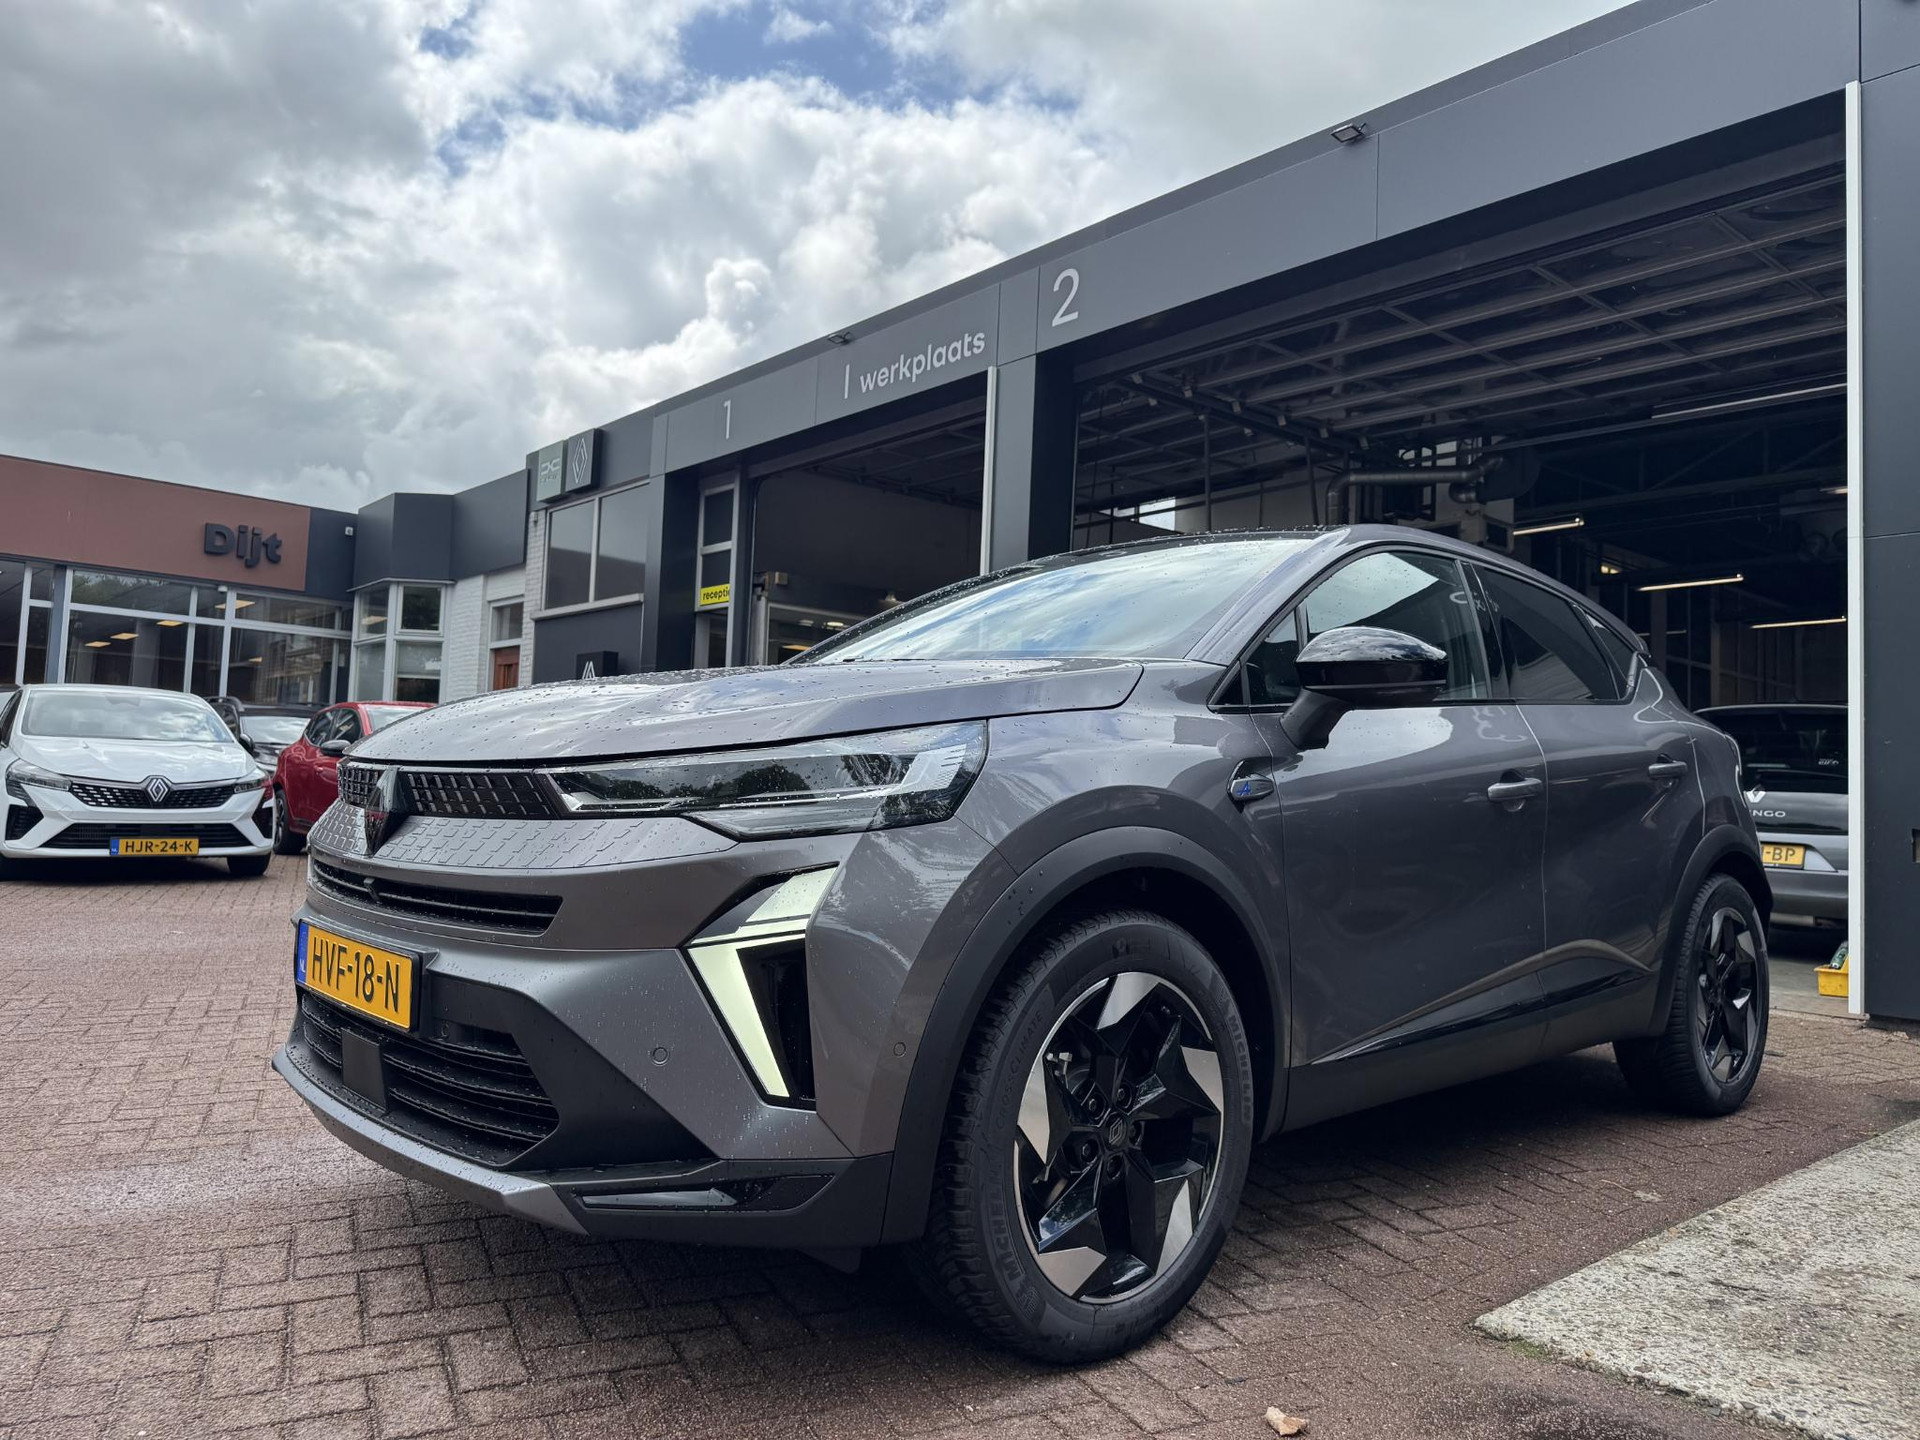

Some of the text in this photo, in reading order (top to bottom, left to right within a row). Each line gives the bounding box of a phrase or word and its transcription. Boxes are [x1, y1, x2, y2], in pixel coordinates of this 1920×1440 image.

[1051, 268, 1080, 328] 2
[860, 332, 986, 394] werkplaats
[723, 400, 731, 440] 1
[204, 523, 283, 569] Dijt
[1750, 809, 1786, 818] NGO
[125, 840, 193, 853] HJR-24-K
[311, 936, 401, 1014] HVF-18-N
